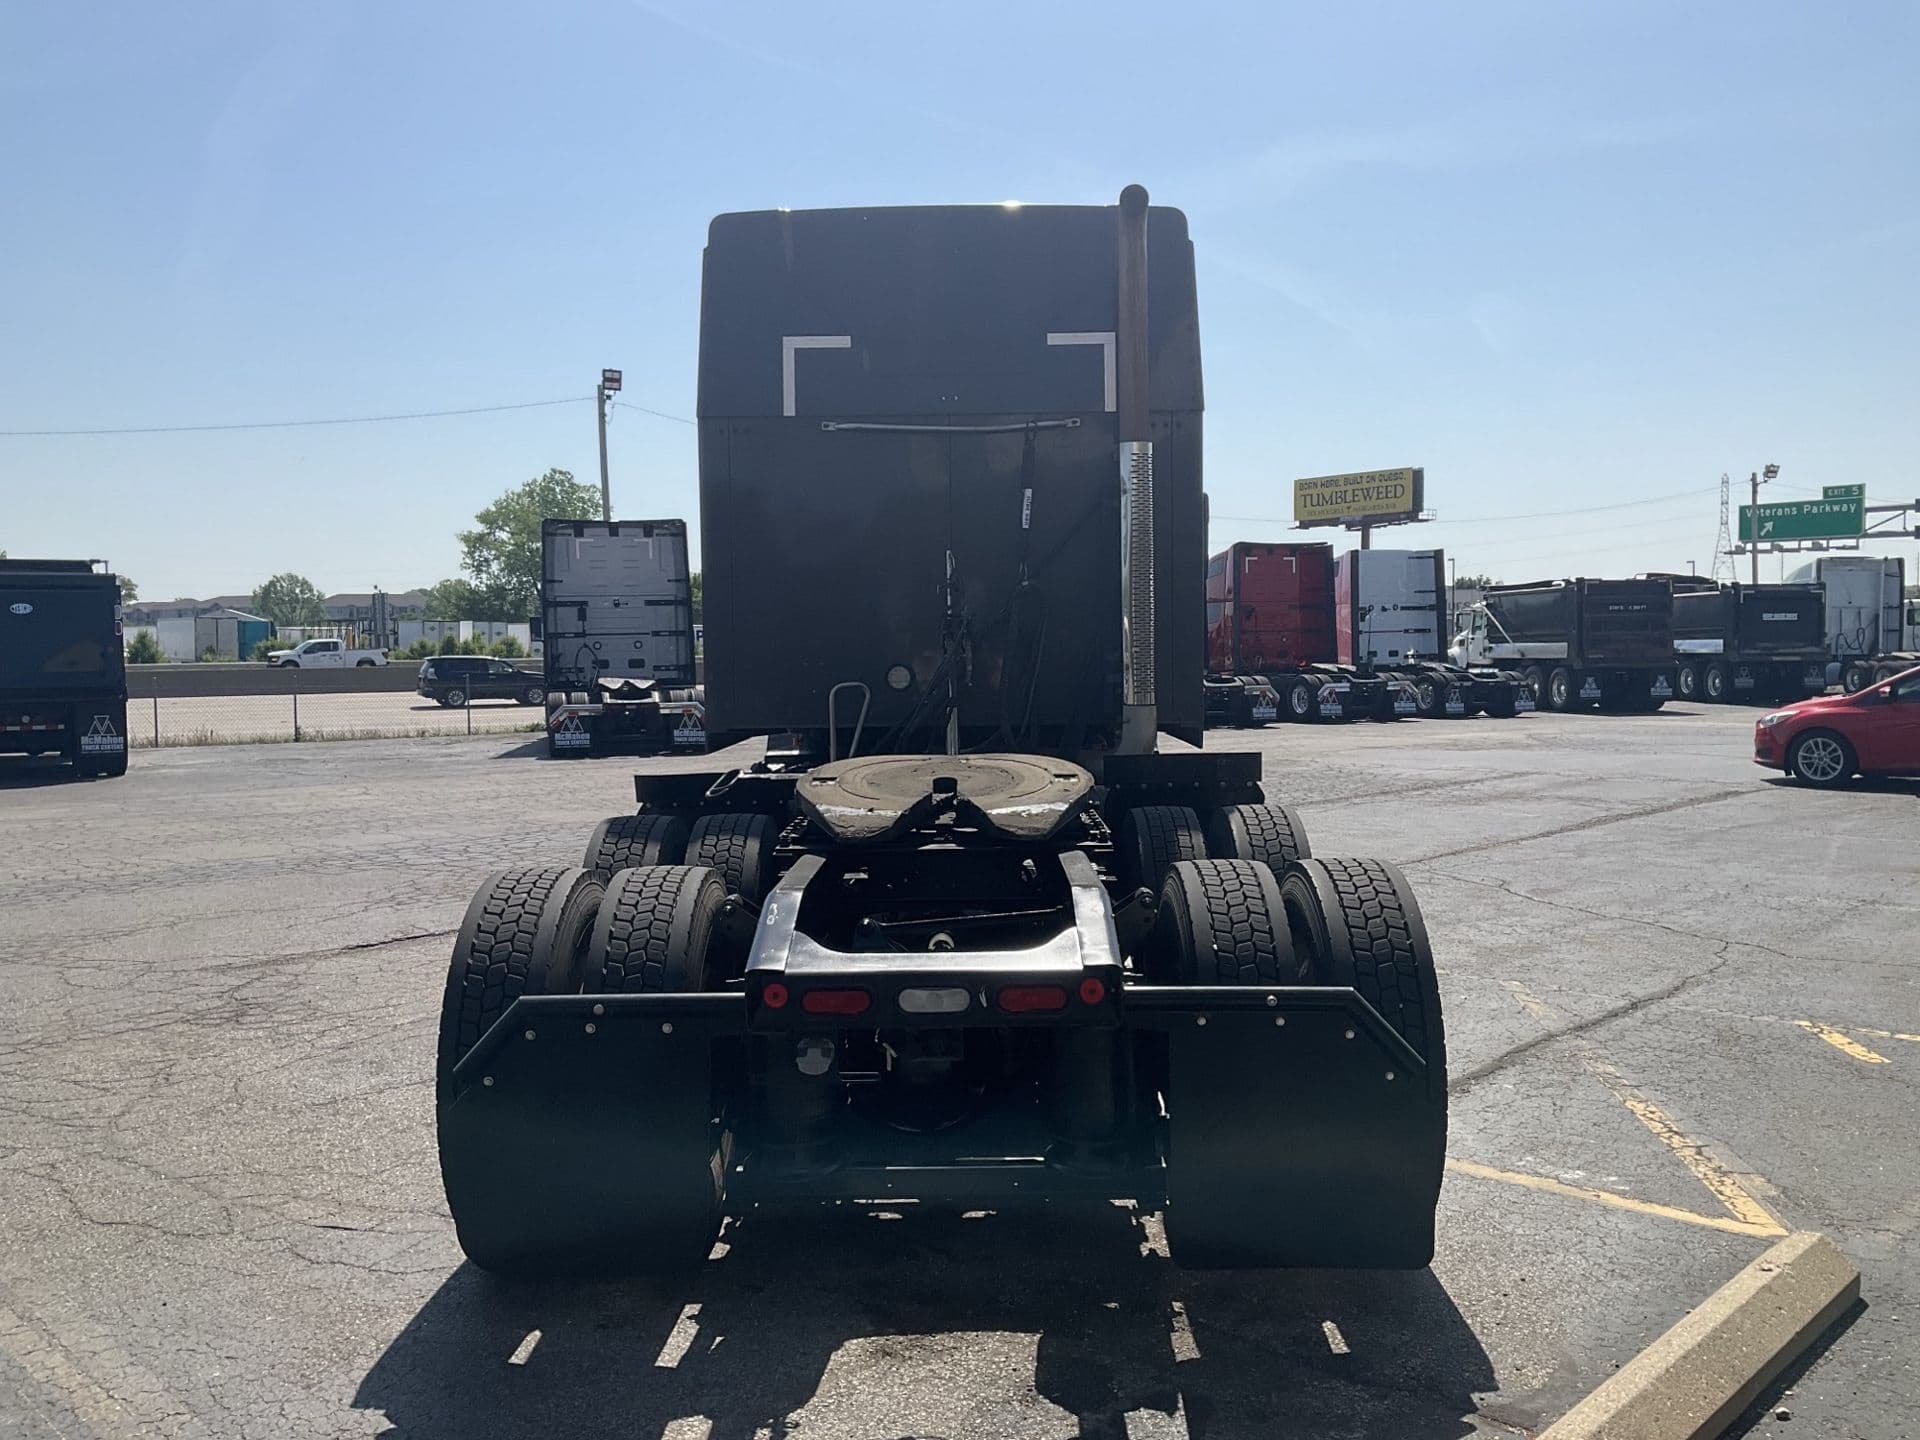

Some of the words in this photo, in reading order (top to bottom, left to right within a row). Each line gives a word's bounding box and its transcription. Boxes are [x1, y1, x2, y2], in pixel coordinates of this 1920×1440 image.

[1301, 483, 1405, 508] TUMBLEWEED
[1828, 488, 1845, 496] EXIT
[1852, 486, 1859, 495] 5
[1746, 507, 1797, 518] Vterans
[1803, 503, 1857, 514] Parkway
[81, 736, 123, 744] McMahon
